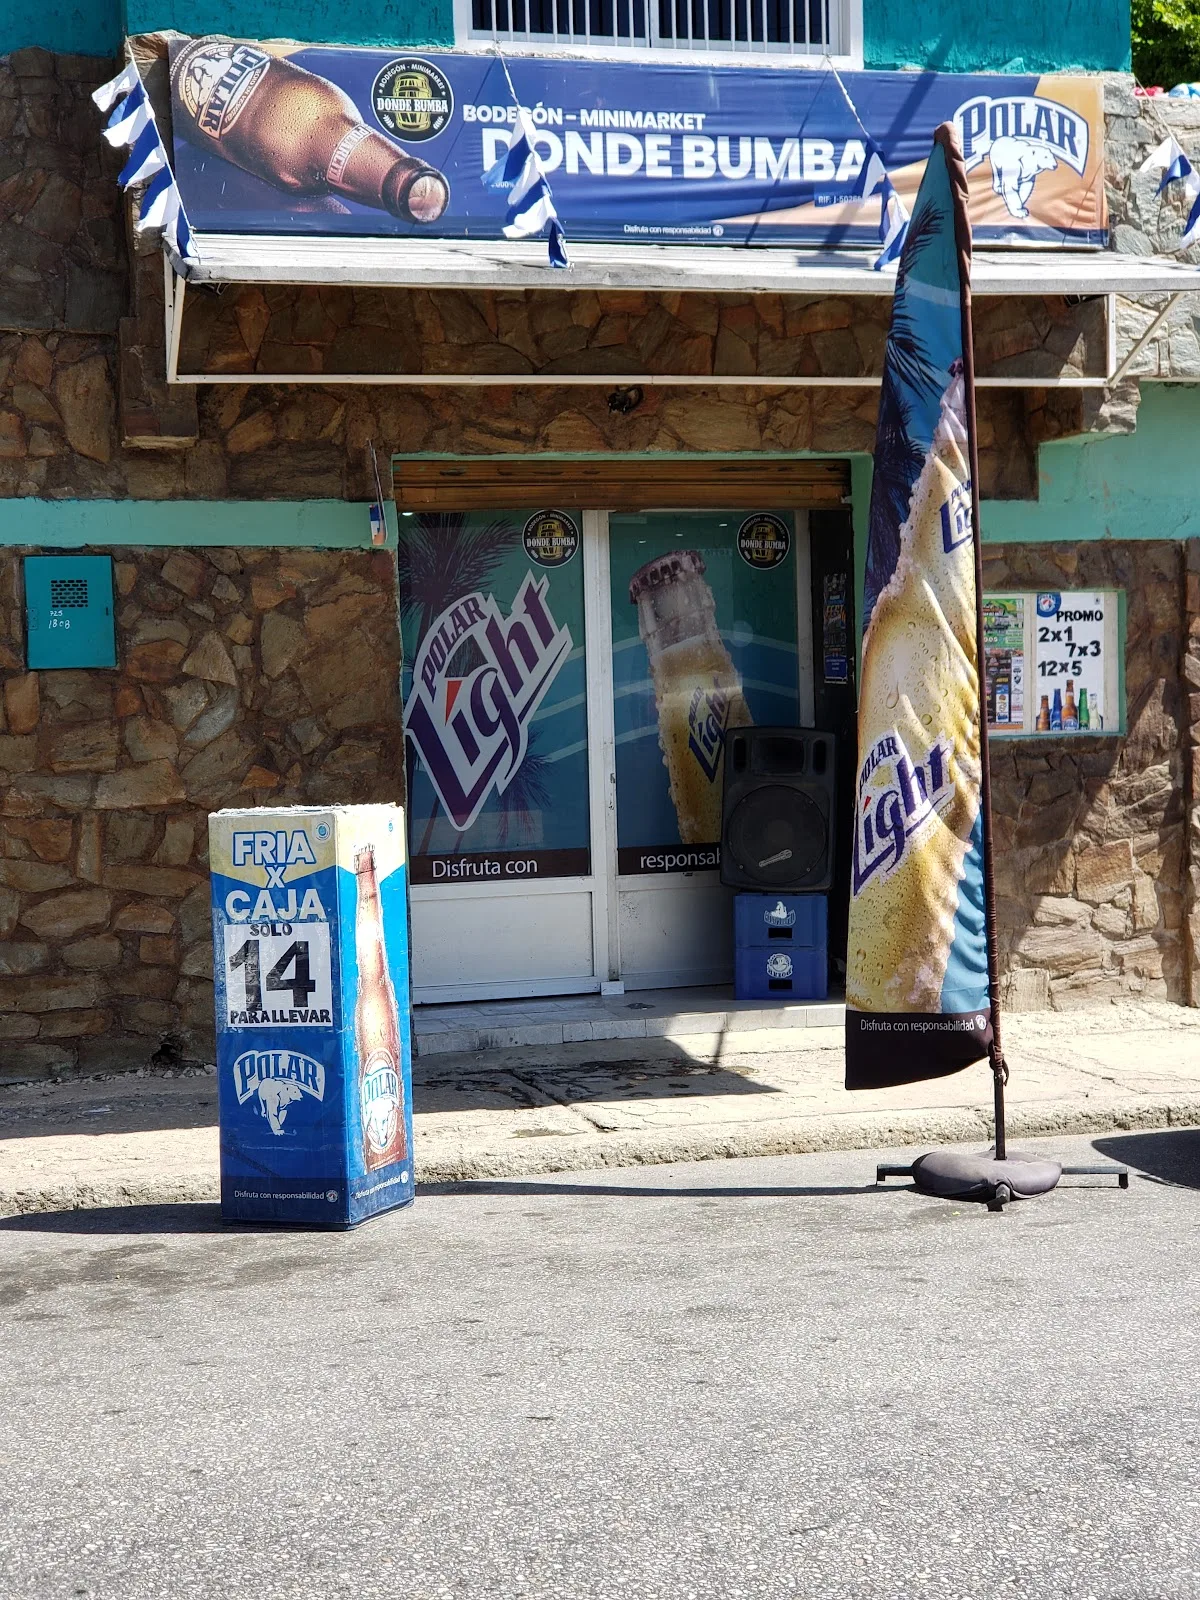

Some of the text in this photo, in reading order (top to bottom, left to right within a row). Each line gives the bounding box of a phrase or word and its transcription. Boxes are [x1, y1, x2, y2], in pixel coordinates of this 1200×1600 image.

[379, 63, 406, 88] BODEGÓN
[411, 63, 446, 90] MINIMARKET
[203, 49, 266, 131] POLAR
[377, 98, 449, 113] DONDE BUMBA
[580, 108, 706, 131] MINIMARKET
[958, 100, 1080, 159] POLAR
[481, 127, 872, 183] DONDE BUMBA
[623, 224, 712, 236] Disfruta con responsabilidad
[526, 537, 576, 548] DONDE BUMBA
[740, 539, 787, 550] DONDE BUMBA
[1056, 610, 1104, 623] PROMO
[1038, 626, 1074, 643] 2x1
[420, 596, 488, 700] POLAR
[1065, 640, 1101, 658] 7x3
[1038, 660, 1083, 677] 12x5
[406, 580, 557, 828] Light
[859, 736, 900, 798] POLAR
[853, 743, 949, 897] Light
[233, 830, 317, 866] FRIA
[264, 865, 285, 888] X
[432, 858, 538, 879] Disfruta con
[225, 888, 327, 921] CAJA
[249, 923, 293, 937] SOLO
[229, 939, 316, 1012] 14
[860, 1018, 975, 1033] Disfruta con responsabilidad
[238, 1052, 320, 1095] POLAR
[364, 1072, 398, 1105] POLAR
[234, 1190, 325, 1200] Disfruta con responsabilidad
